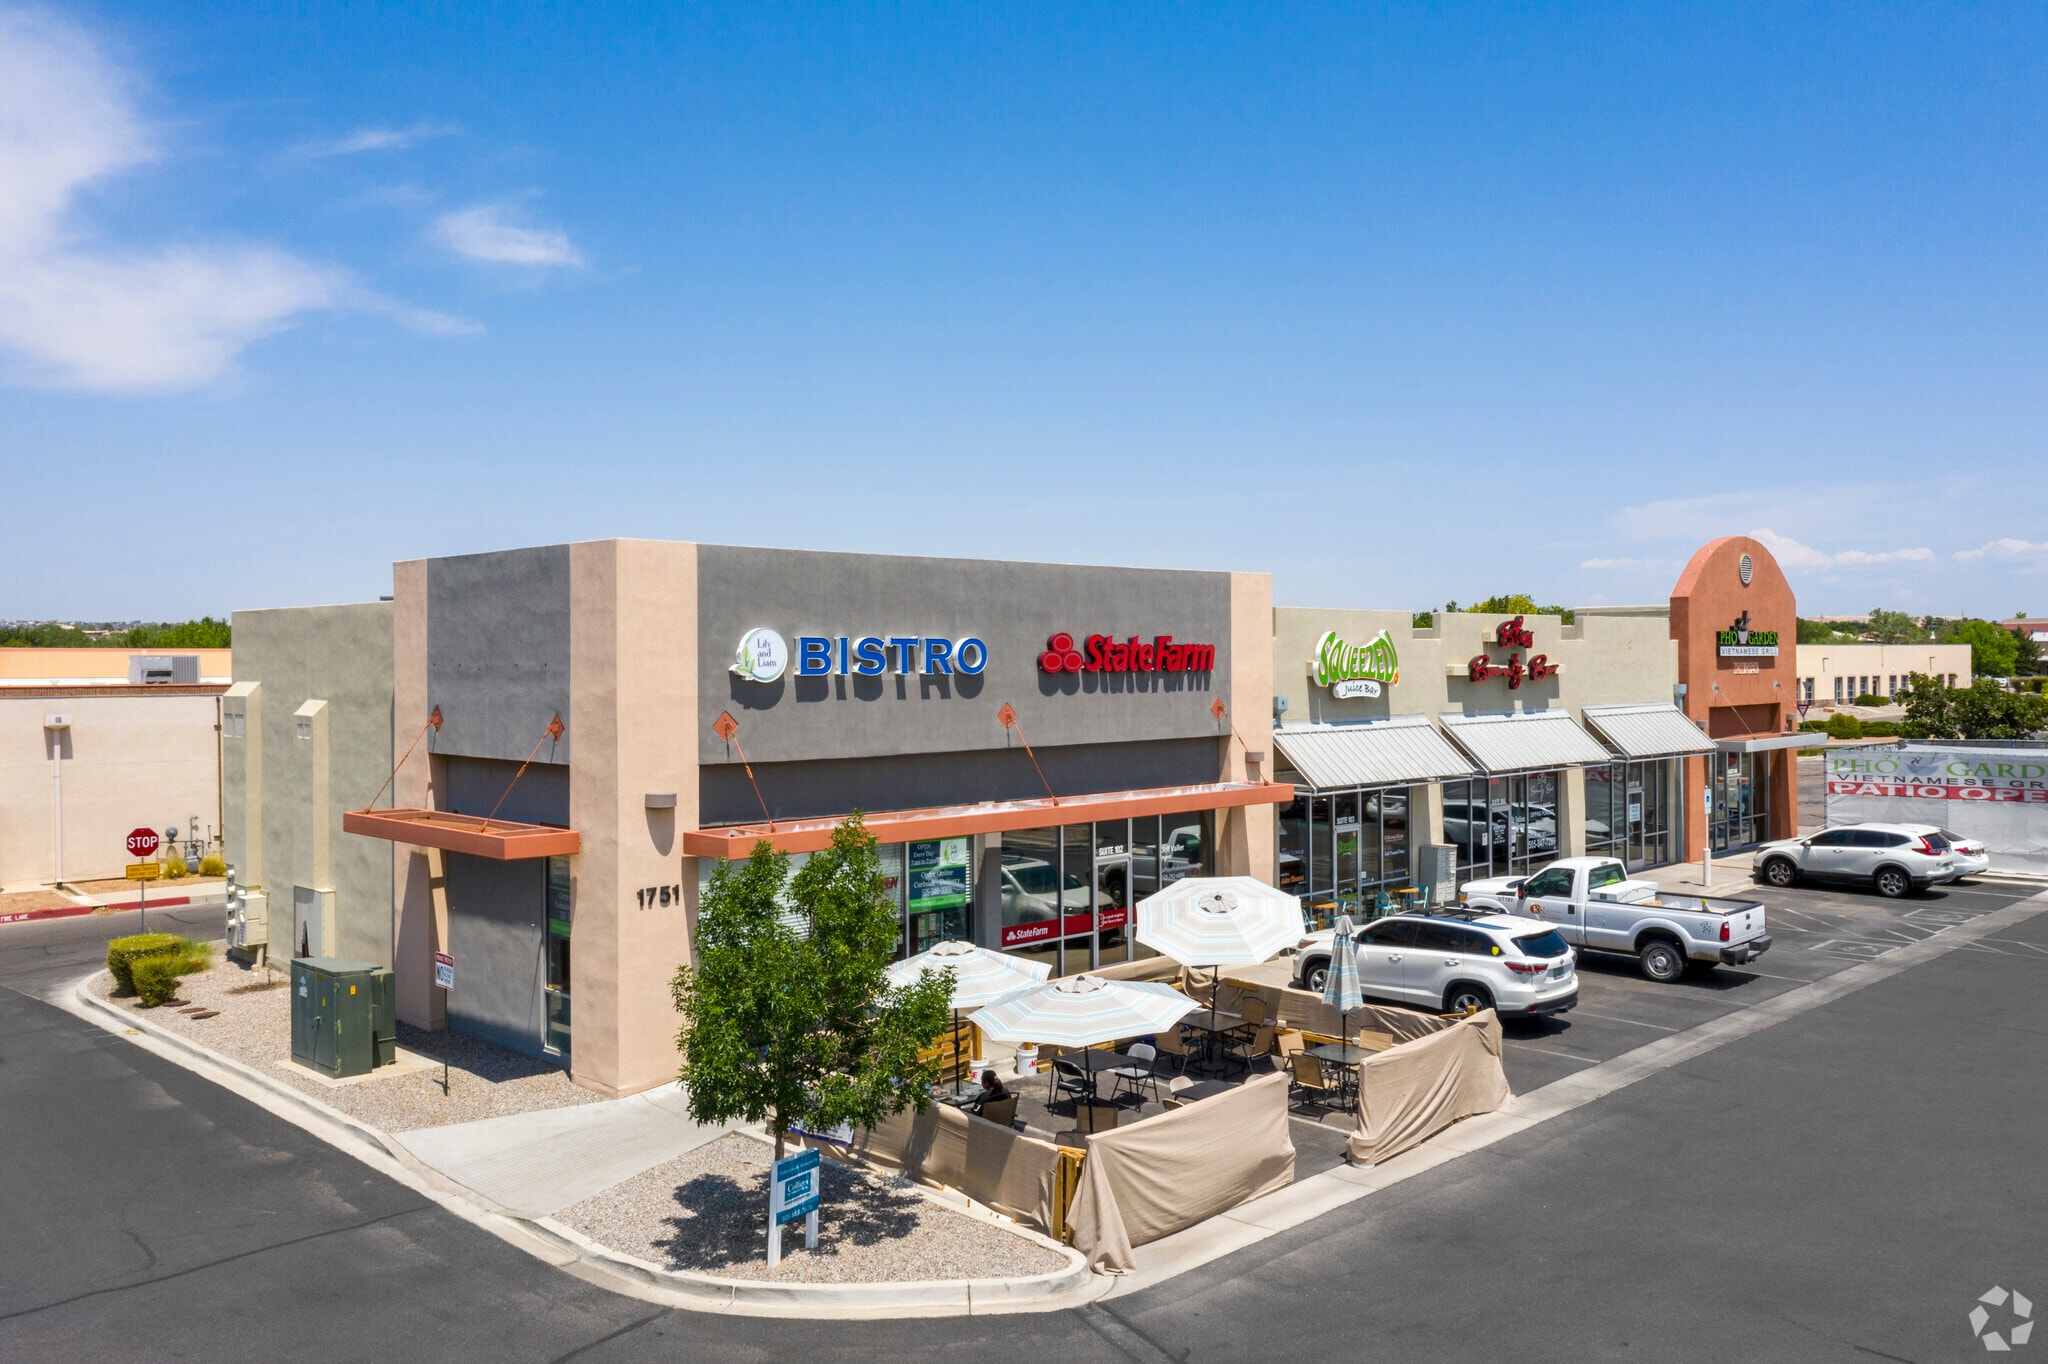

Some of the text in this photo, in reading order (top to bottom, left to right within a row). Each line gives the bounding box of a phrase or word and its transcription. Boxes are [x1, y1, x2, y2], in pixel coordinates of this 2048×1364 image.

[757, 638, 772, 650] Lily
[1748, 631, 1778, 645] GARDEN
[757, 649, 772, 658] and
[797, 636, 988, 676] BISTRO
[1721, 647, 1778, 655] VIETNAMESE GRILL
[757, 657, 777, 668] Liam
[1528, 654, 1559, 681] Bar
[1364, 684, 1378, 695] Bar
[1837, 774, 1995, 787] VIETNAMESE
[1834, 782, 2046, 802] PATIO OPE
[1337, 817, 1348, 825] SUITE
[128, 836, 157, 848] STOP
[1098, 845, 1124, 855] SUITE 102
[637, 885, 679, 907] 1751
[787, 1180, 809, 1193] Colliers
